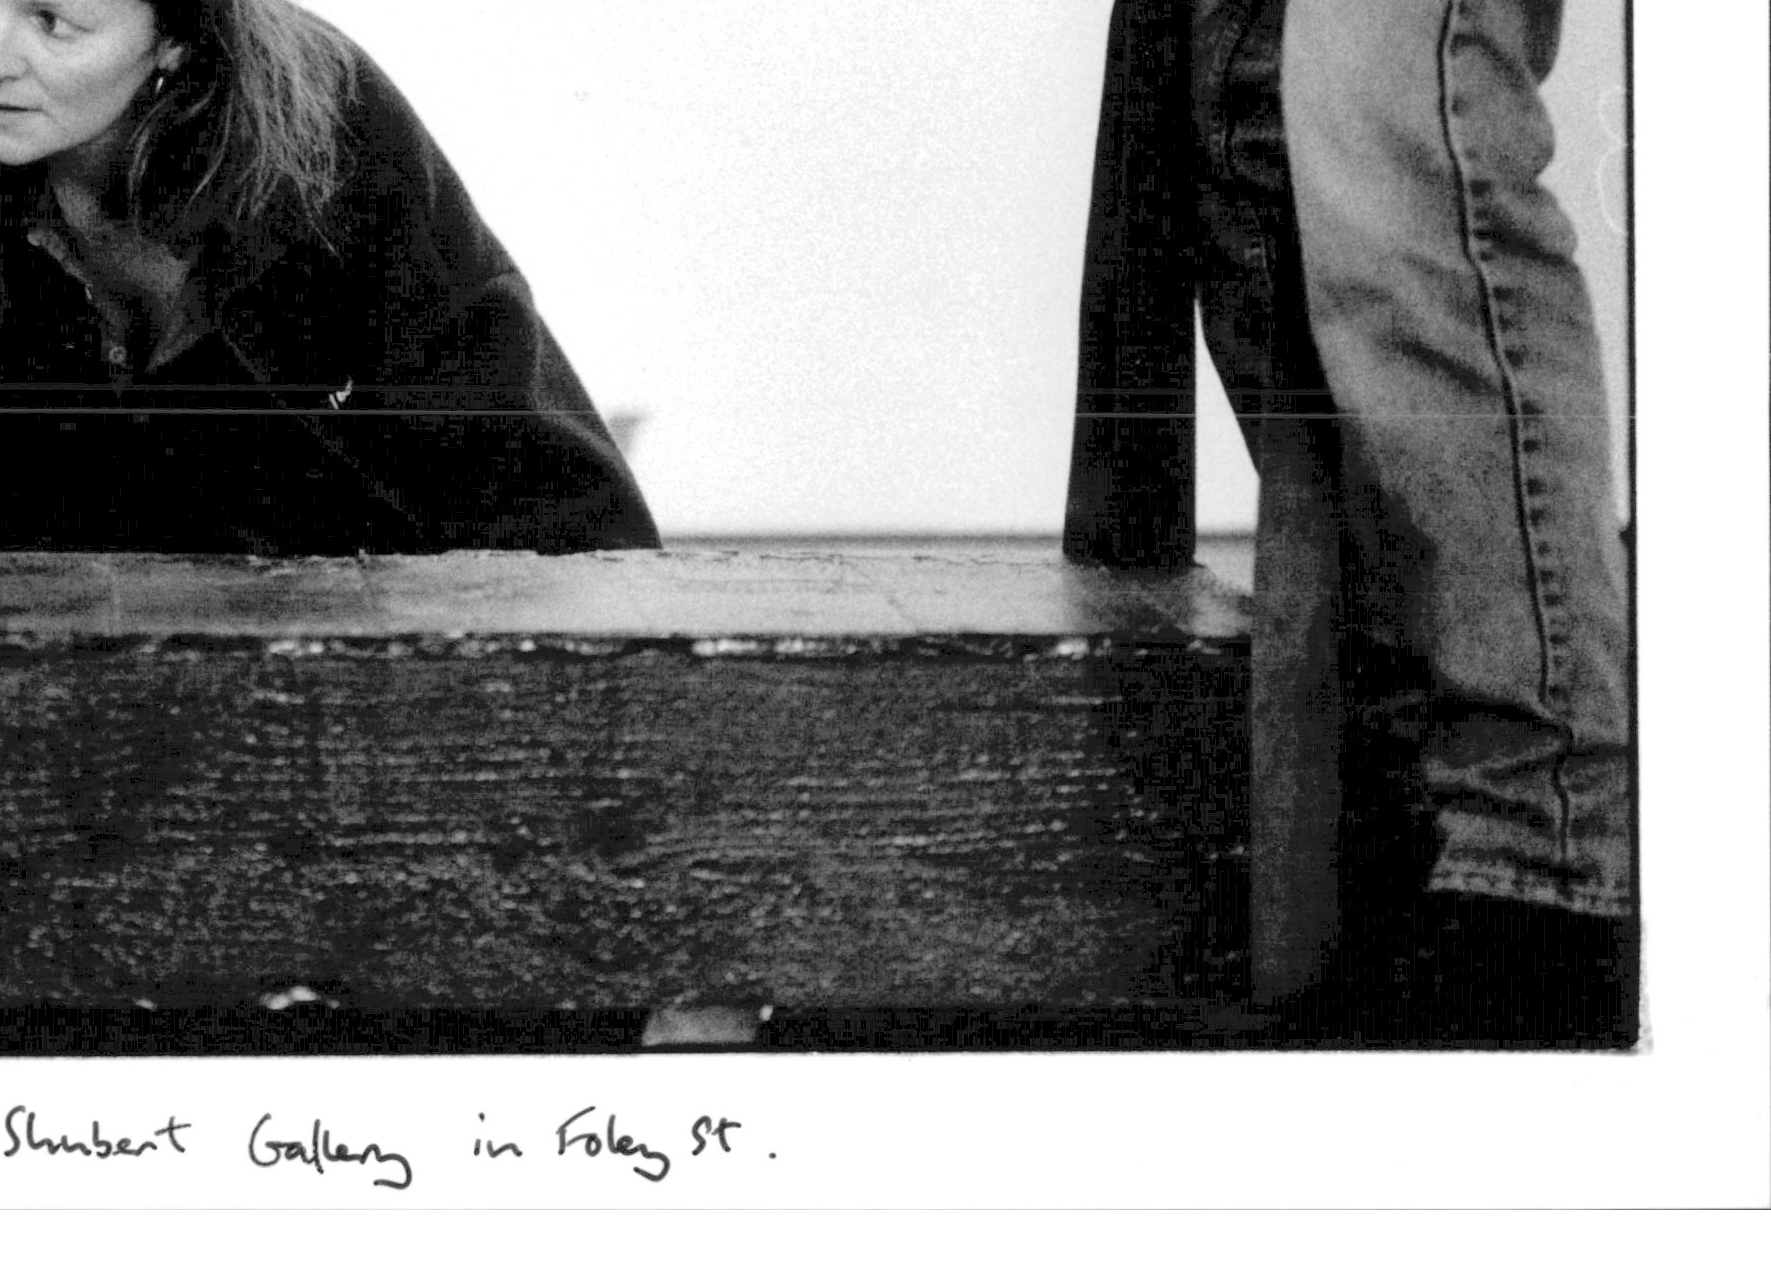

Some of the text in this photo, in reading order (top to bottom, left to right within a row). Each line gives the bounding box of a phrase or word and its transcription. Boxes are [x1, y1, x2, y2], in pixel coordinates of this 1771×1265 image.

[248, 1113, 413, 1190] Gallery
[473, 1112, 523, 1159] in
[555, 1105, 671, 1183] Foley
